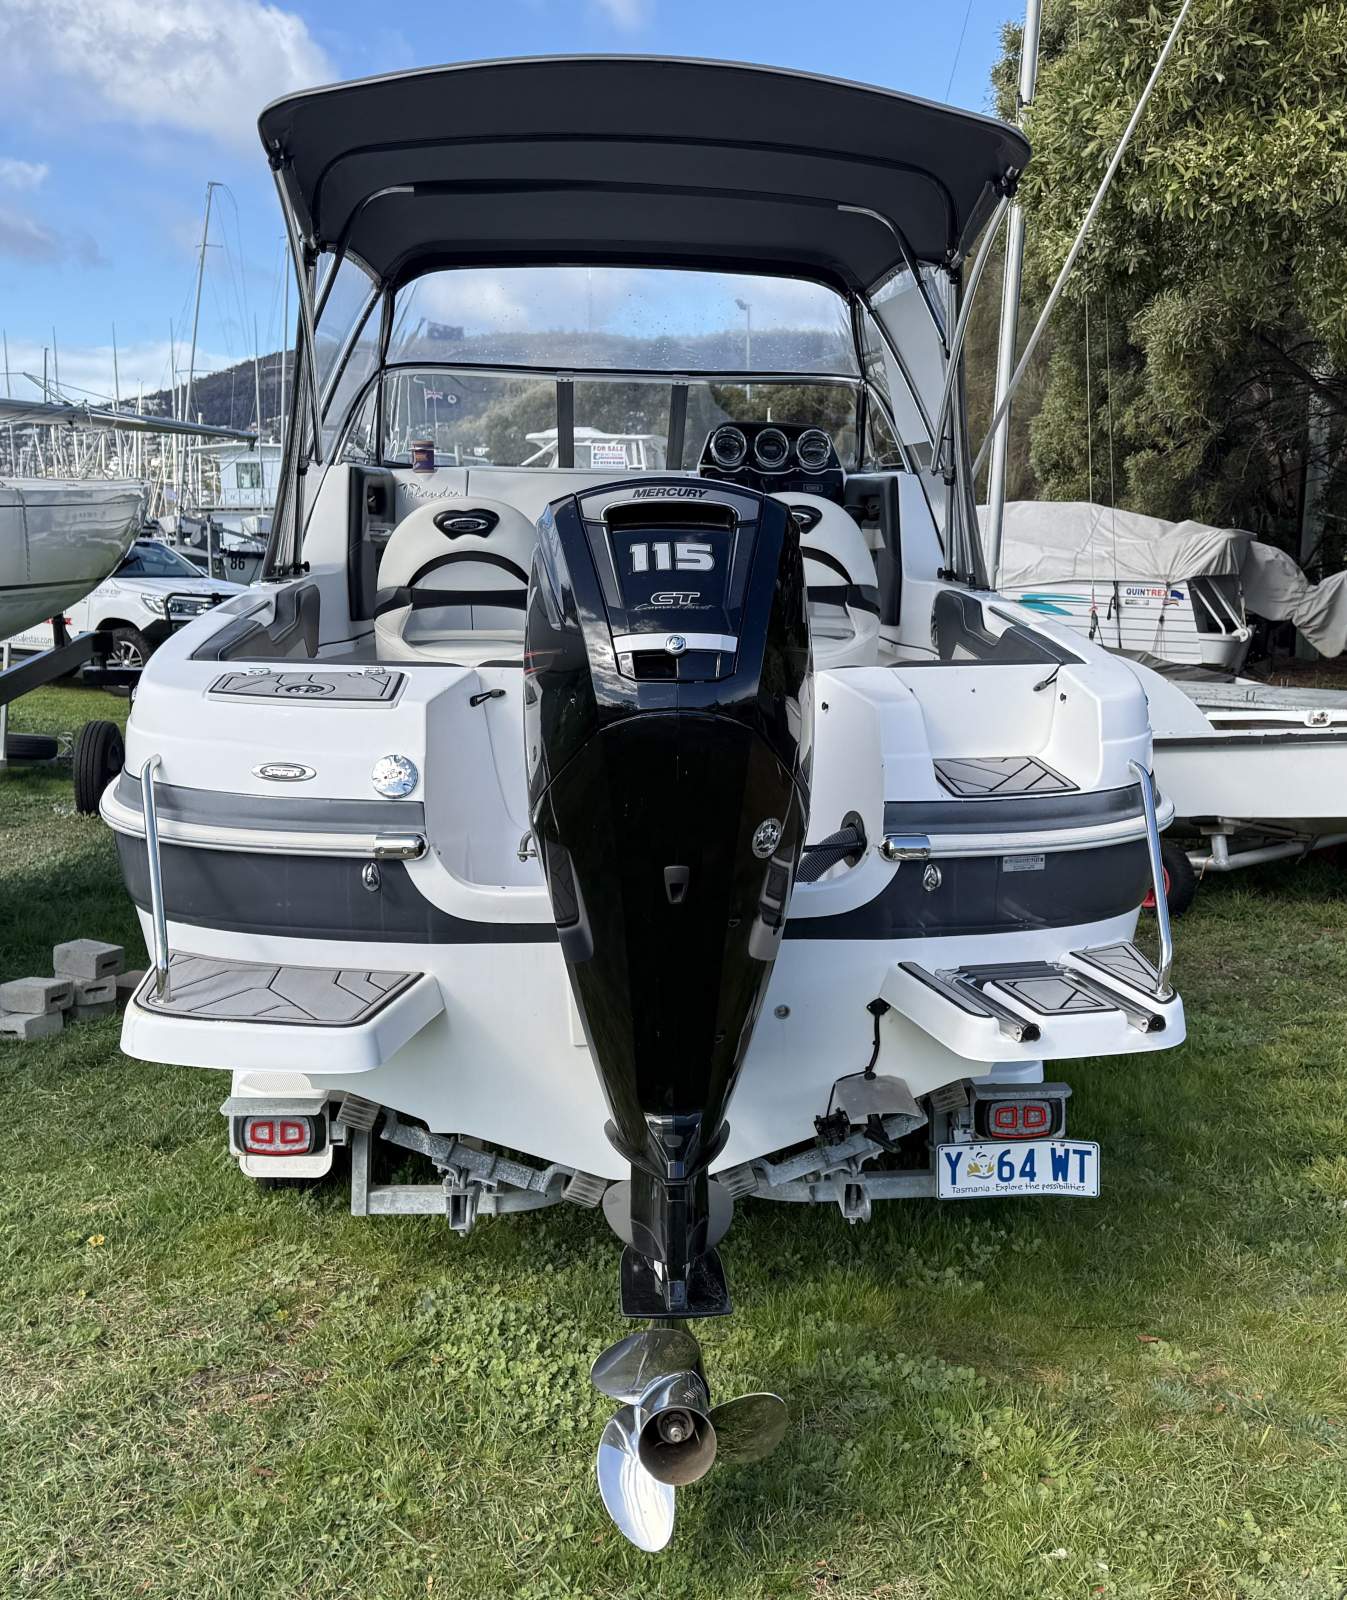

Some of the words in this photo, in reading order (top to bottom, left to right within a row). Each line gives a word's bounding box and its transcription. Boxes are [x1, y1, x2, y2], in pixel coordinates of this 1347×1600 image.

[632, 486, 709, 499] MERCURY
[230, 557, 245, 570] 86
[629, 541, 715, 573] 115
[1126, 587, 1168, 597] QUINTREX
[944, 1151, 963, 1185] Y
[997, 1148, 1037, 1183] 64
[1050, 1147, 1092, 1183] WT
[952, 1185, 990, 1194] Tasmania
[995, 1183, 1023, 1193] Explore
[1025, 1182, 1040, 1190] the
[1041, 1182, 1086, 1192] possibilities
